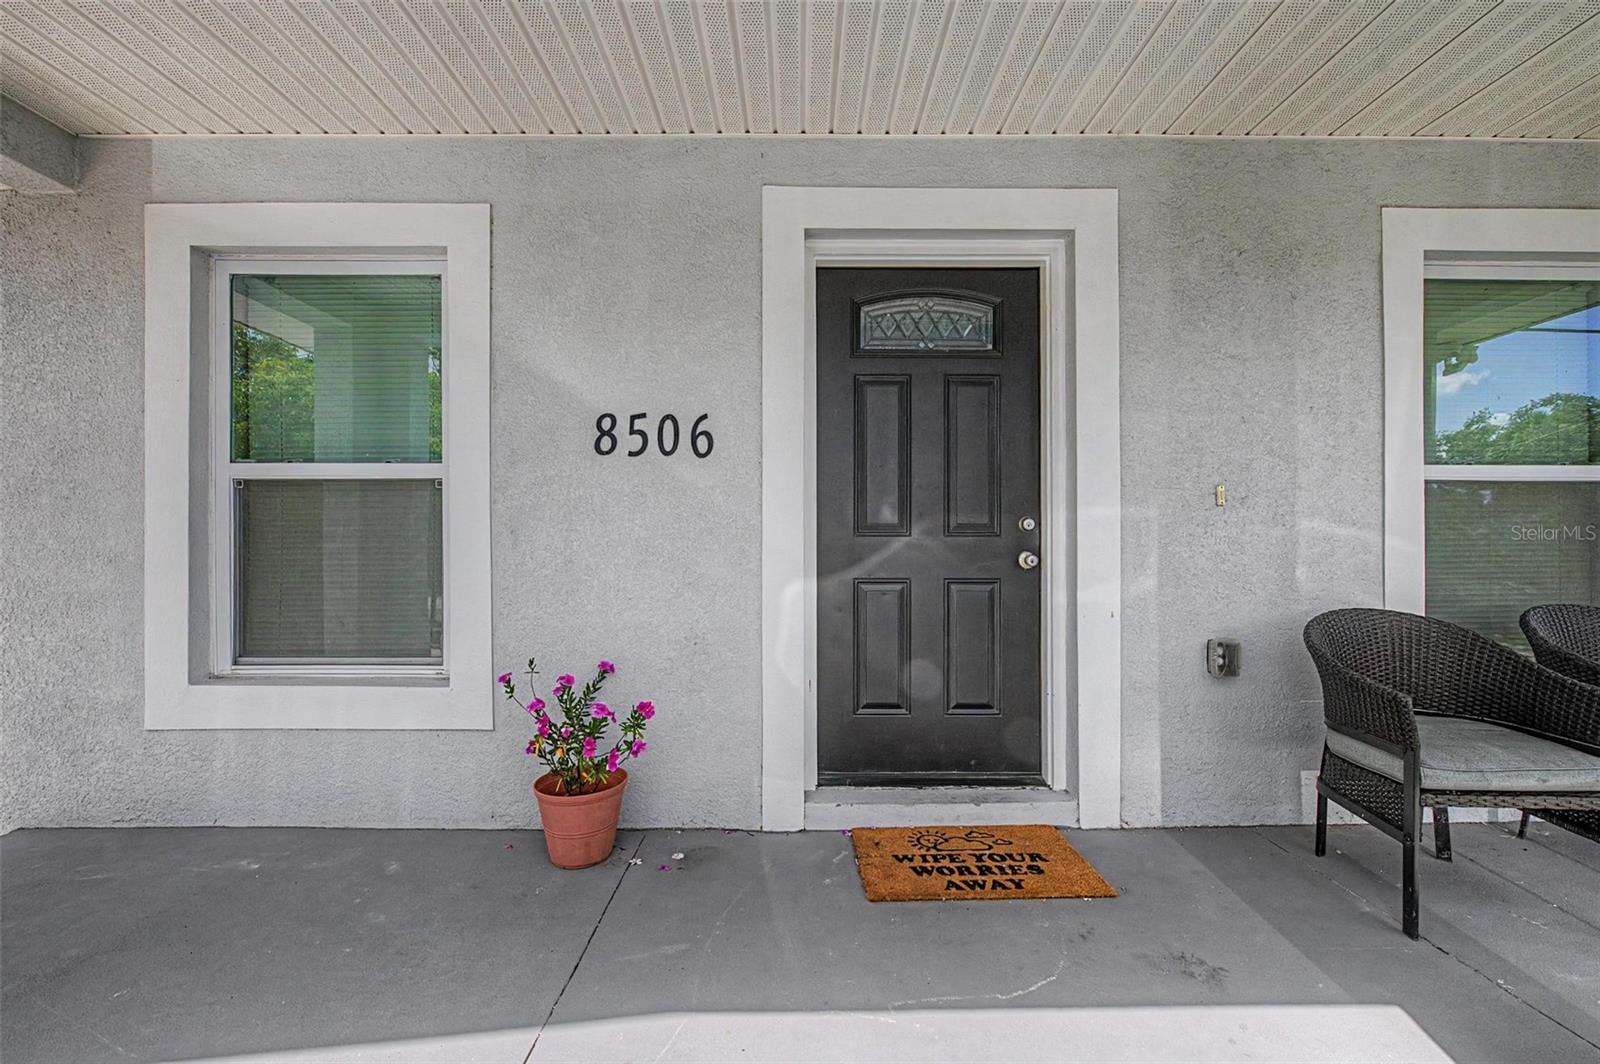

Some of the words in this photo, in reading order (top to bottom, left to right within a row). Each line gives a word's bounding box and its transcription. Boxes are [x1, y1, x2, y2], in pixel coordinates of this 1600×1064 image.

[594, 412, 714, 459] 8506
[892, 853, 962, 864] WIPE
[970, 852, 1050, 864] YOUR
[910, 864, 1045, 877] WORRIES
[944, 878, 1025, 891] AWAY
